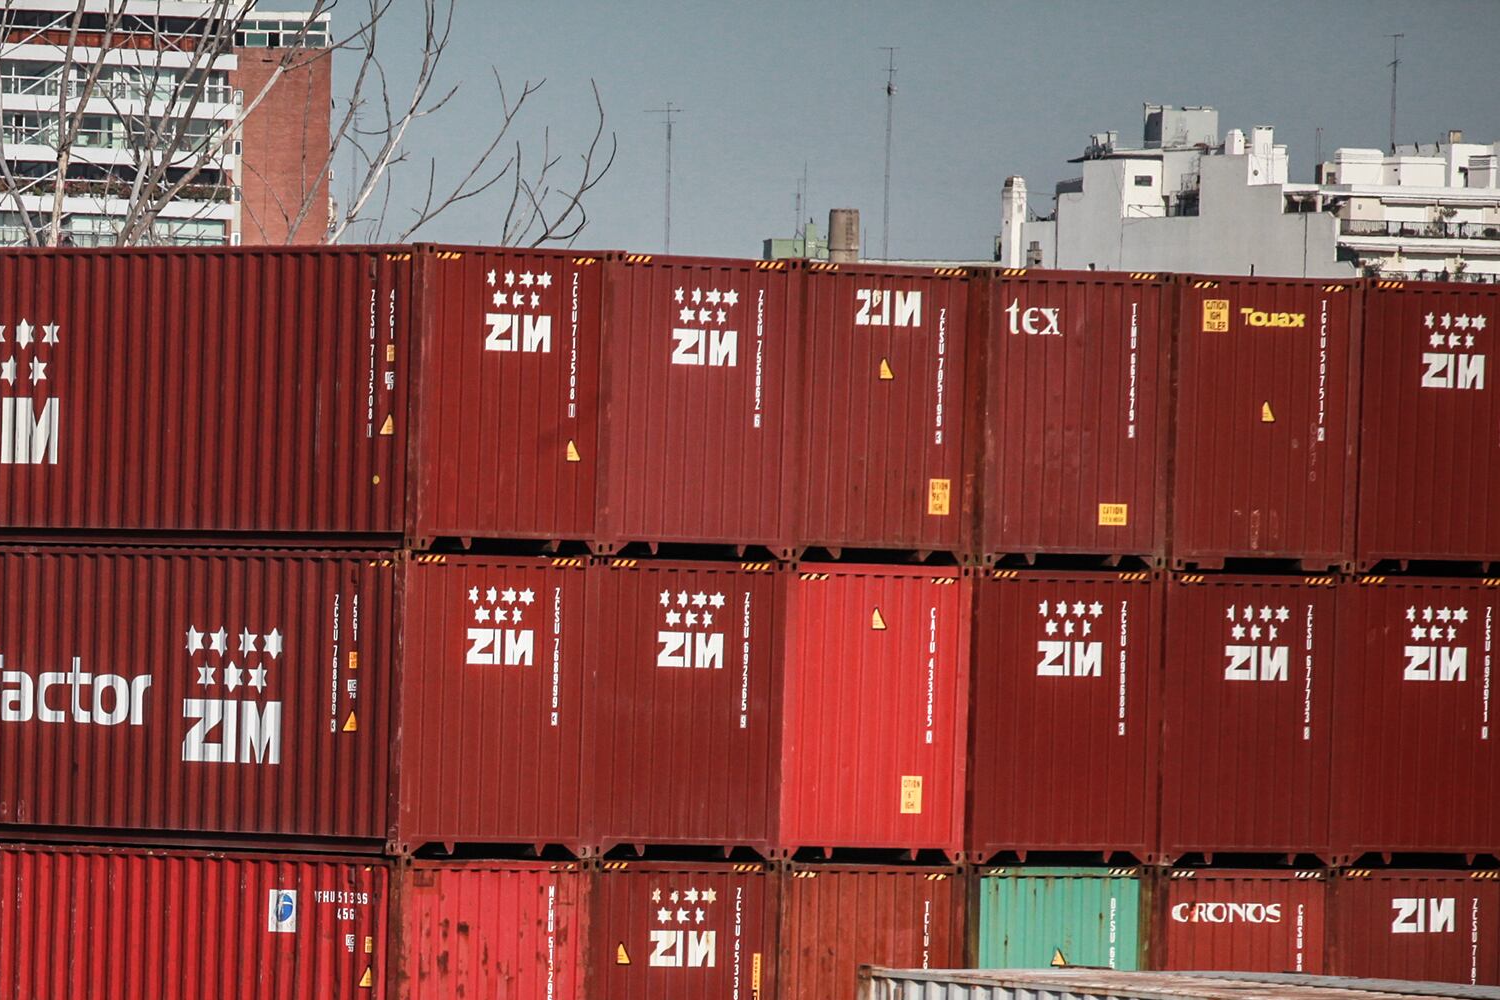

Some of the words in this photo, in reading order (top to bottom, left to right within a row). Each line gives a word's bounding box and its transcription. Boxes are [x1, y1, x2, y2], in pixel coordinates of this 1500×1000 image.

[571, 272, 579, 323] ZCSU
[855, 290, 921, 328] ZIM
[1005, 297, 1062, 336] tex
[485, 313, 551, 353] ZIM
[672, 328, 738, 367] ZIM
[938, 308, 946, 355] ZCSU
[569, 325, 577, 400] 713508
[754, 340, 762, 411] 755062
[1421, 352, 1485, 390] ZIM
[1318, 350, 1326, 424] 507517
[553, 587, 561, 635] ZCSU
[466, 628, 534, 666] ZIM
[657, 631, 724, 669] ZIM
[1037, 641, 1102, 677] ZIM
[1224, 645, 1289, 681] ZIM
[1403, 645, 1467, 682] ZIM
[552, 639, 560, 708] 768999
[741, 642, 749, 711] 692365
[1304, 655, 1312, 722] 677733
[181, 698, 282, 765] ZIM
[734, 887, 742, 937] ZCSU
[1172, 902, 1281, 923] CRONOS
[1392, 898, 1455, 934] ZIM
[649, 930, 716, 968] ZIM
